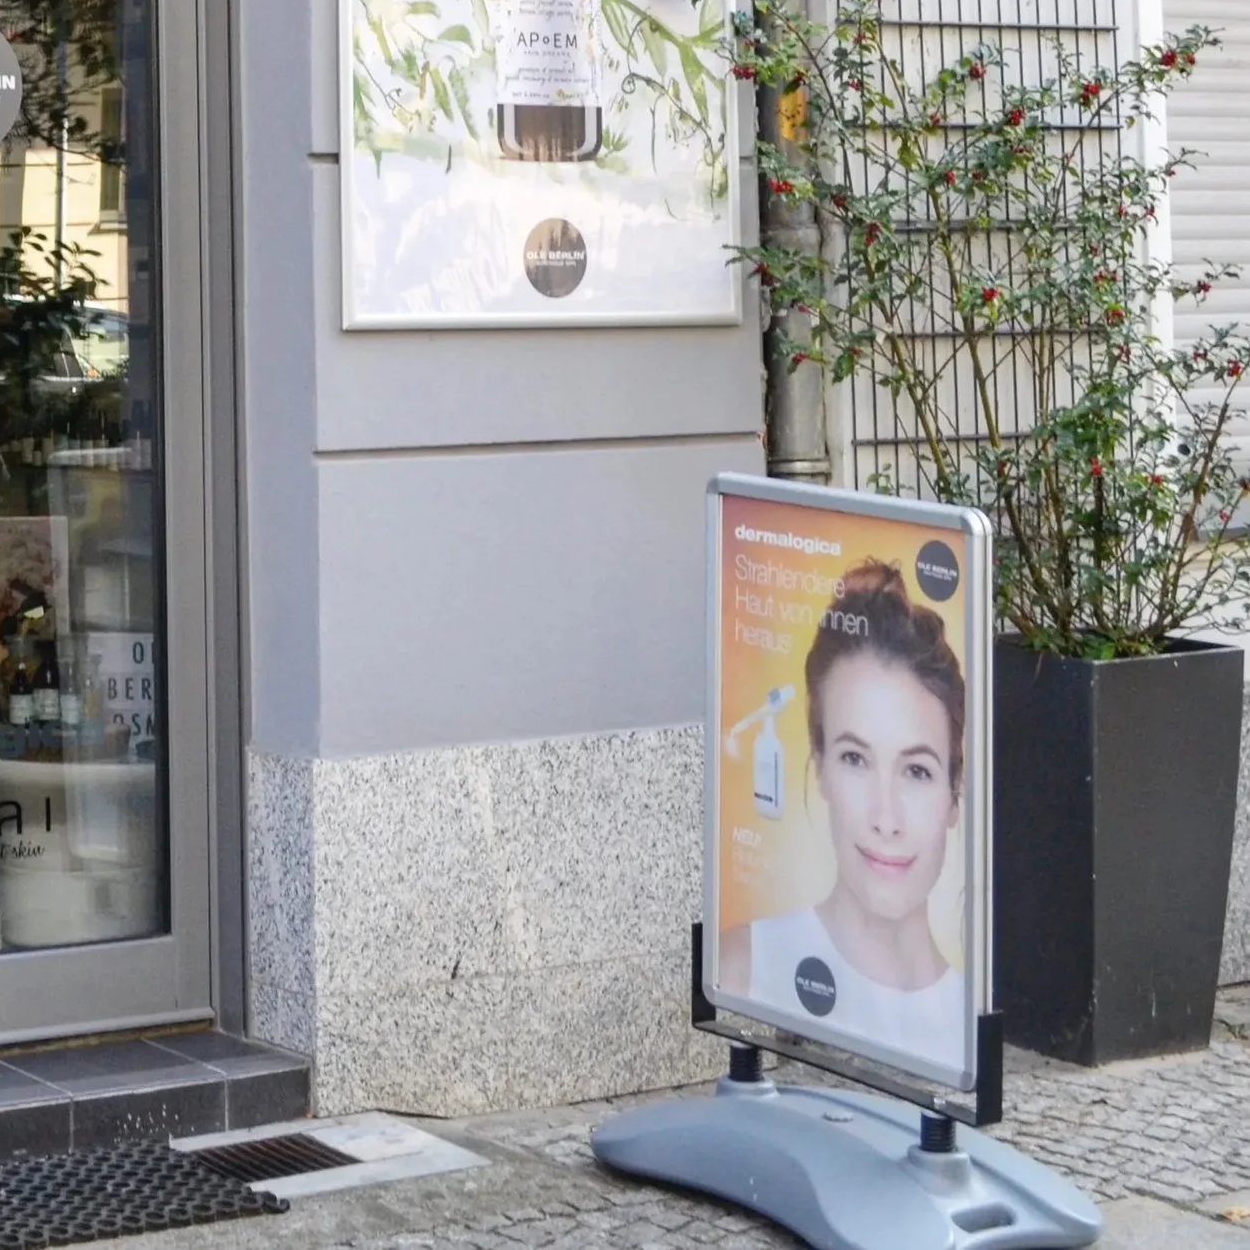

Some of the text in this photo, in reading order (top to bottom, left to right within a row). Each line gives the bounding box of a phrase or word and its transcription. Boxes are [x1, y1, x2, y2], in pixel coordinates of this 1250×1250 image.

[734, 523, 842, 556] dermalogica
[735, 553, 846, 599] Strahlendere
[735, 585, 774, 618] Haut
[779, 600, 814, 625] von
[734, 617, 792, 654] heraus
[7, 840, 46, 860] skin
